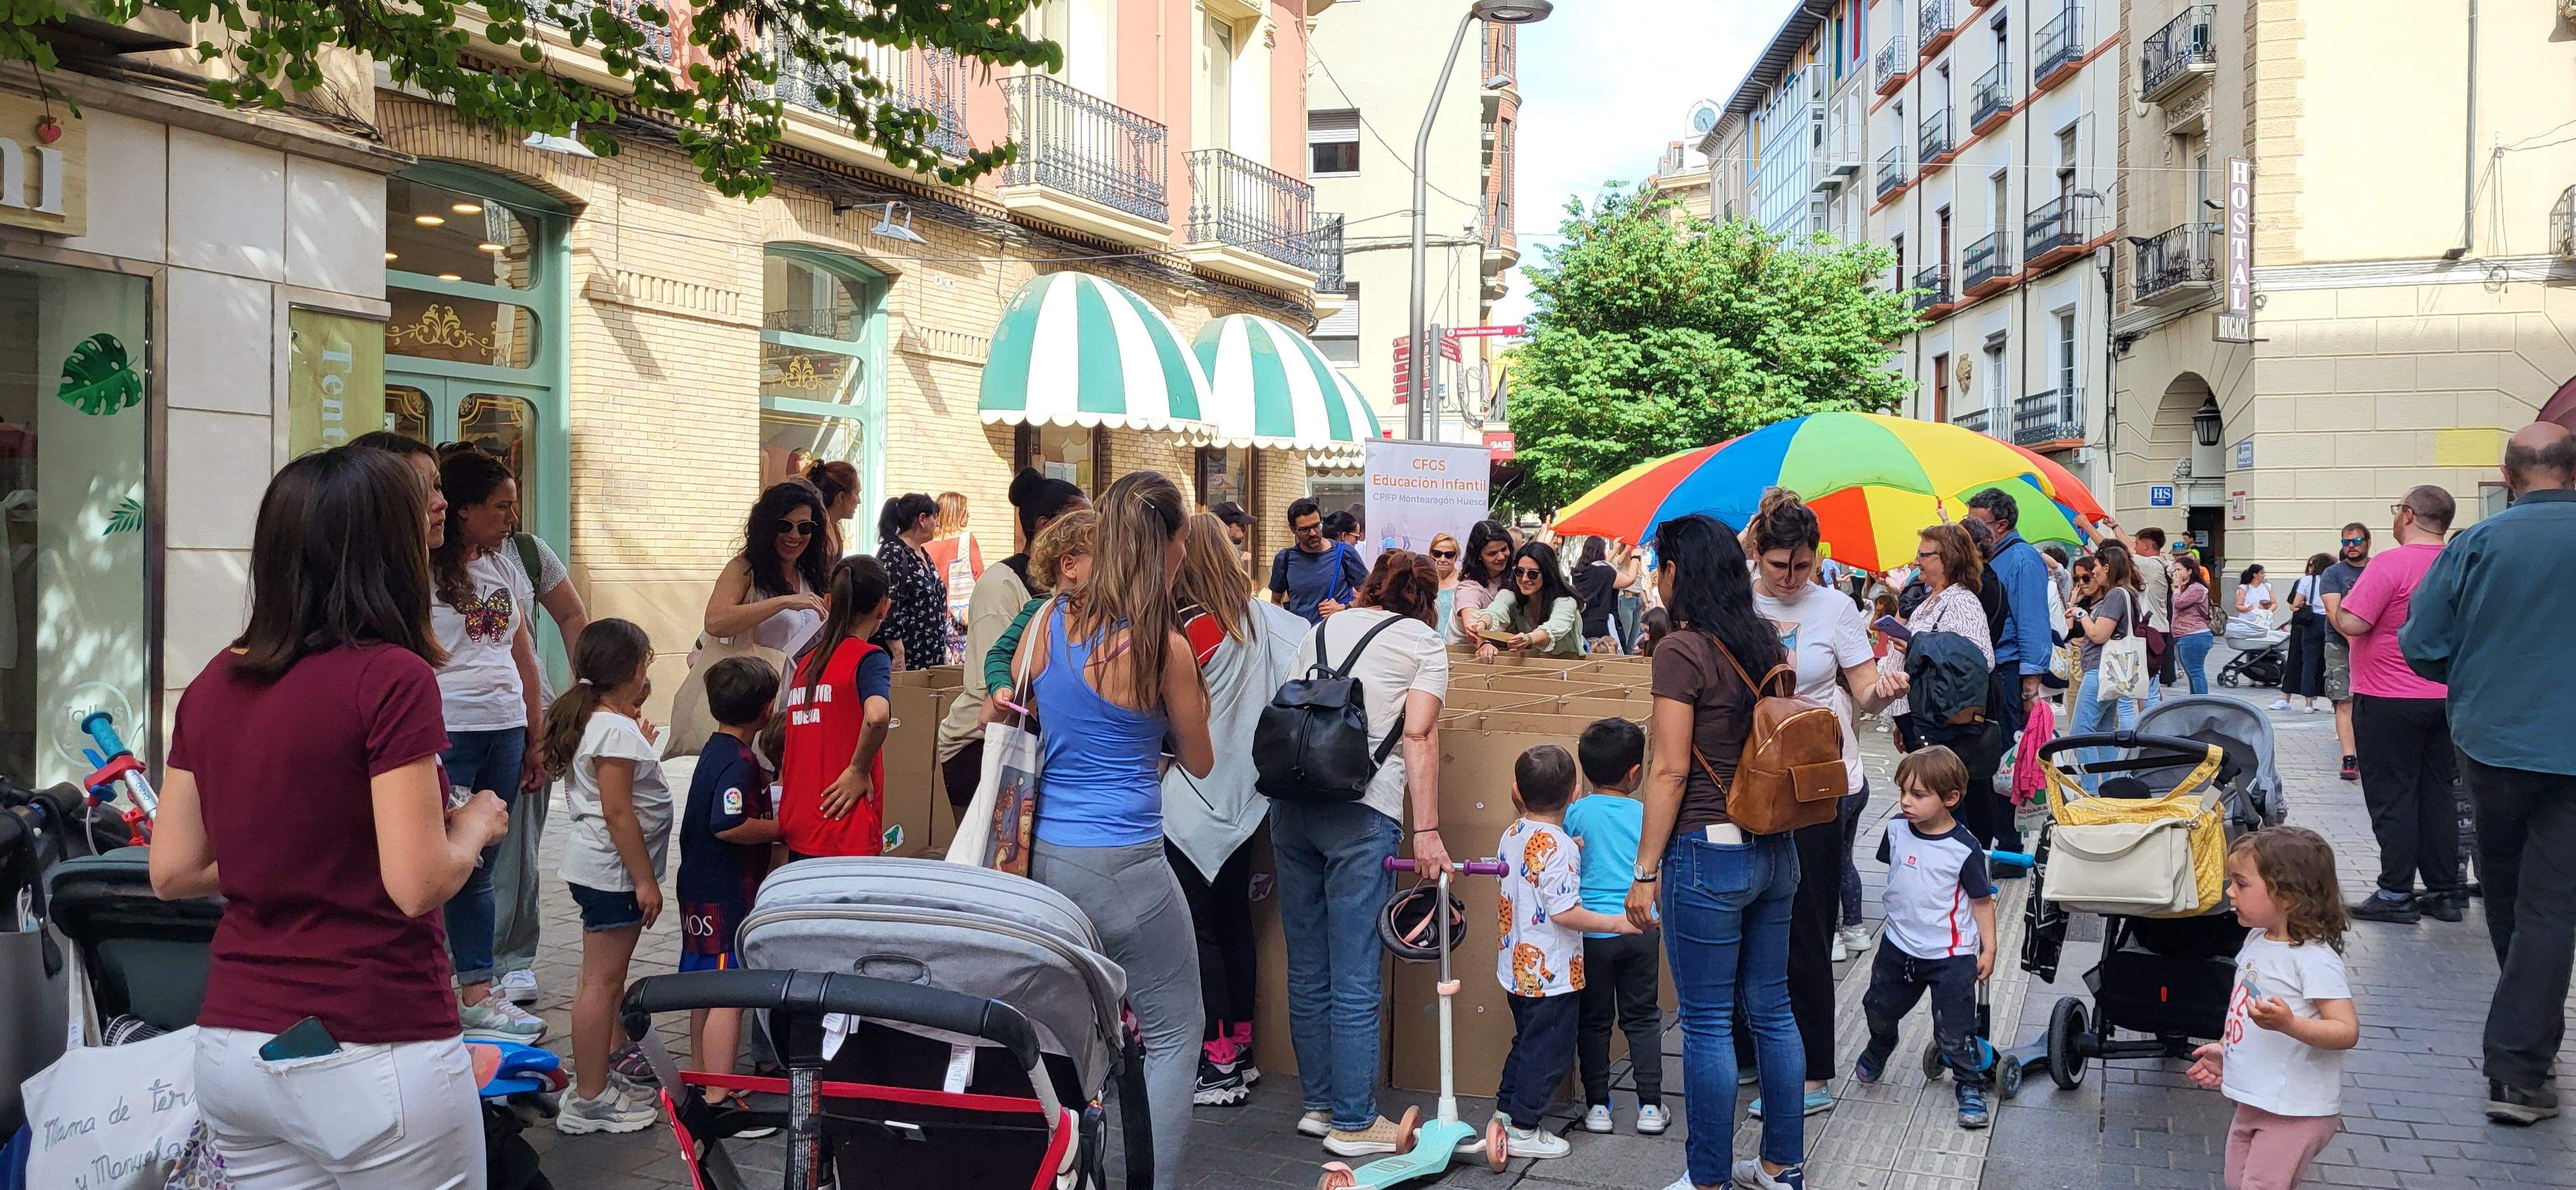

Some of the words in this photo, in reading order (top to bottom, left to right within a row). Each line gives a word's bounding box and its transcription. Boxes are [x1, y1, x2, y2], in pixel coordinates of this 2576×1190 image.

[2230, 161, 2248, 310] HOSTAL
[2219, 315, 2249, 340] RUGACA
[322, 341, 352, 449] Tent
[1412, 458, 1446, 471] CFGS
[1373, 474, 1438, 489] Educación
[1441, 478, 1486, 491] Infantil
[2153, 487, 2171, 500] HS
[1372, 493, 1397, 502] CPIFP
[1399, 494, 1455, 506] Montearagón
[1457, 498, 1486, 506] Huesca
[108, 1095, 131, 1124] de
[75, 1173, 88, 1190] y
[91, 1136, 182, 1185] Manuela
